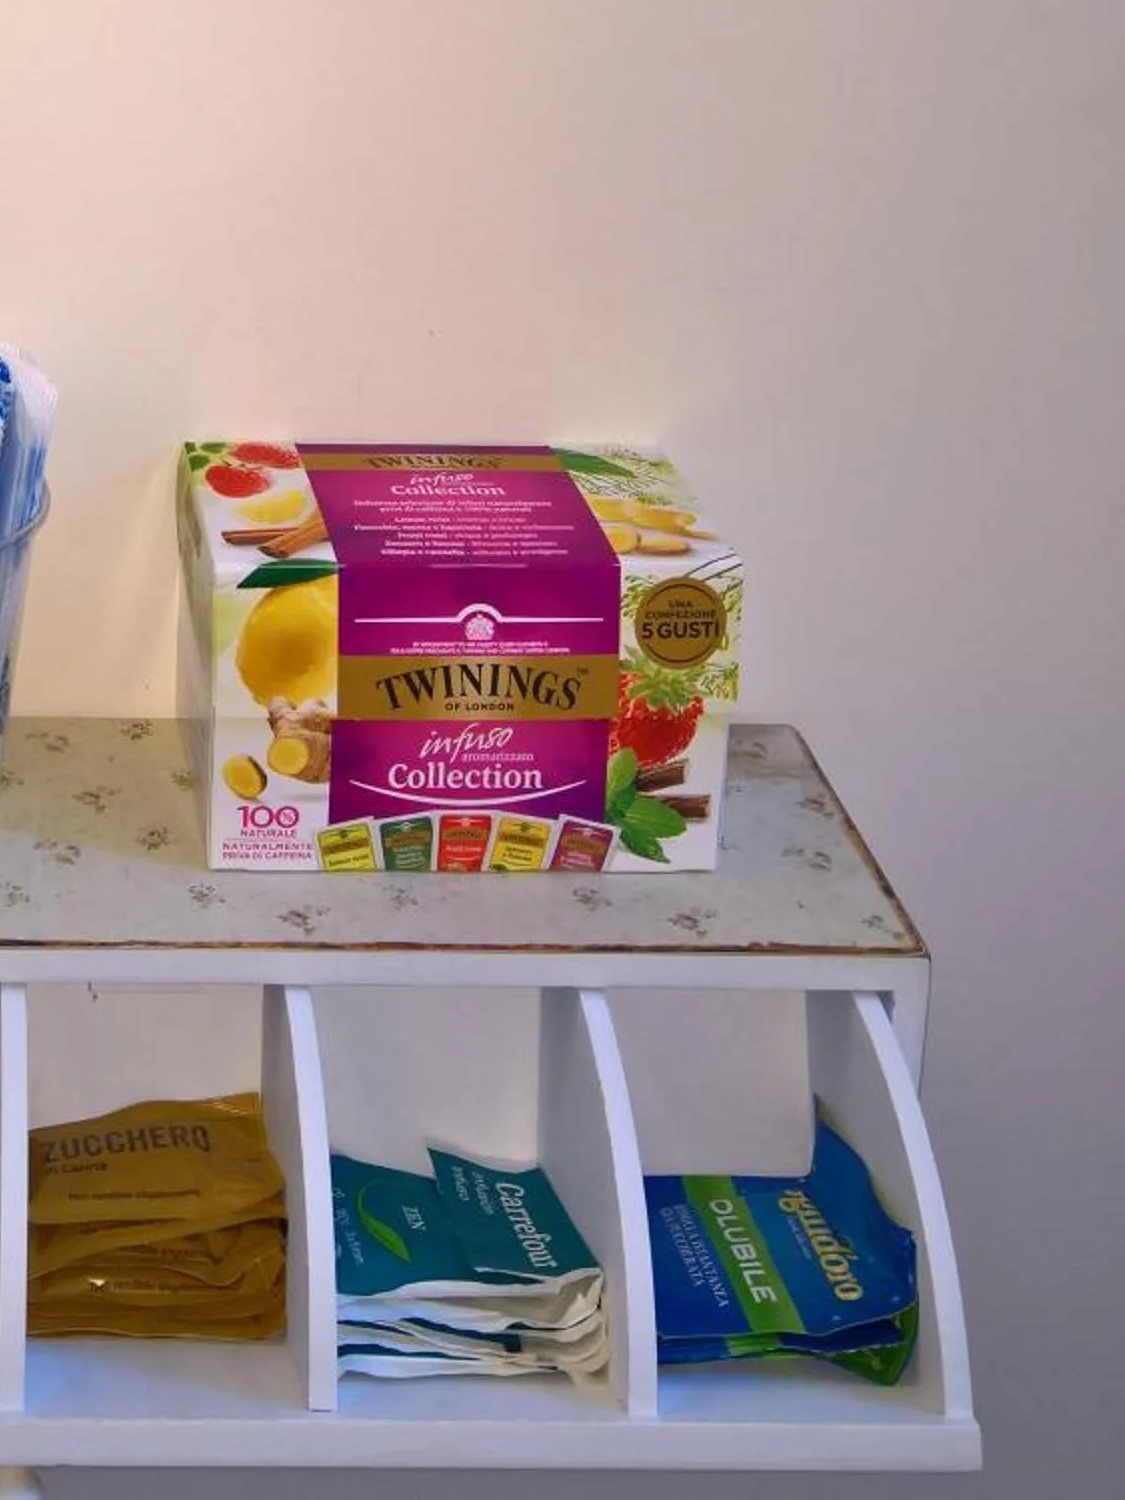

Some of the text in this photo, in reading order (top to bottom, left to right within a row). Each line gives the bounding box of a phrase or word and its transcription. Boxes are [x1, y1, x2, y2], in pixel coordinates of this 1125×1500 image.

[390, 484, 507, 497] Collection
[642, 621, 720, 639] 5 GUSTI
[377, 663, 582, 712] TWININGS
[445, 703, 514, 712] OF LONDON
[419, 722, 514, 764] infuso
[388, 763, 543, 789] Collection
[42, 1124, 212, 1165] ZUCCHERO
[495, 1181, 558, 1269] Carrefour
[708, 1198, 779, 1304] OLUBILE
